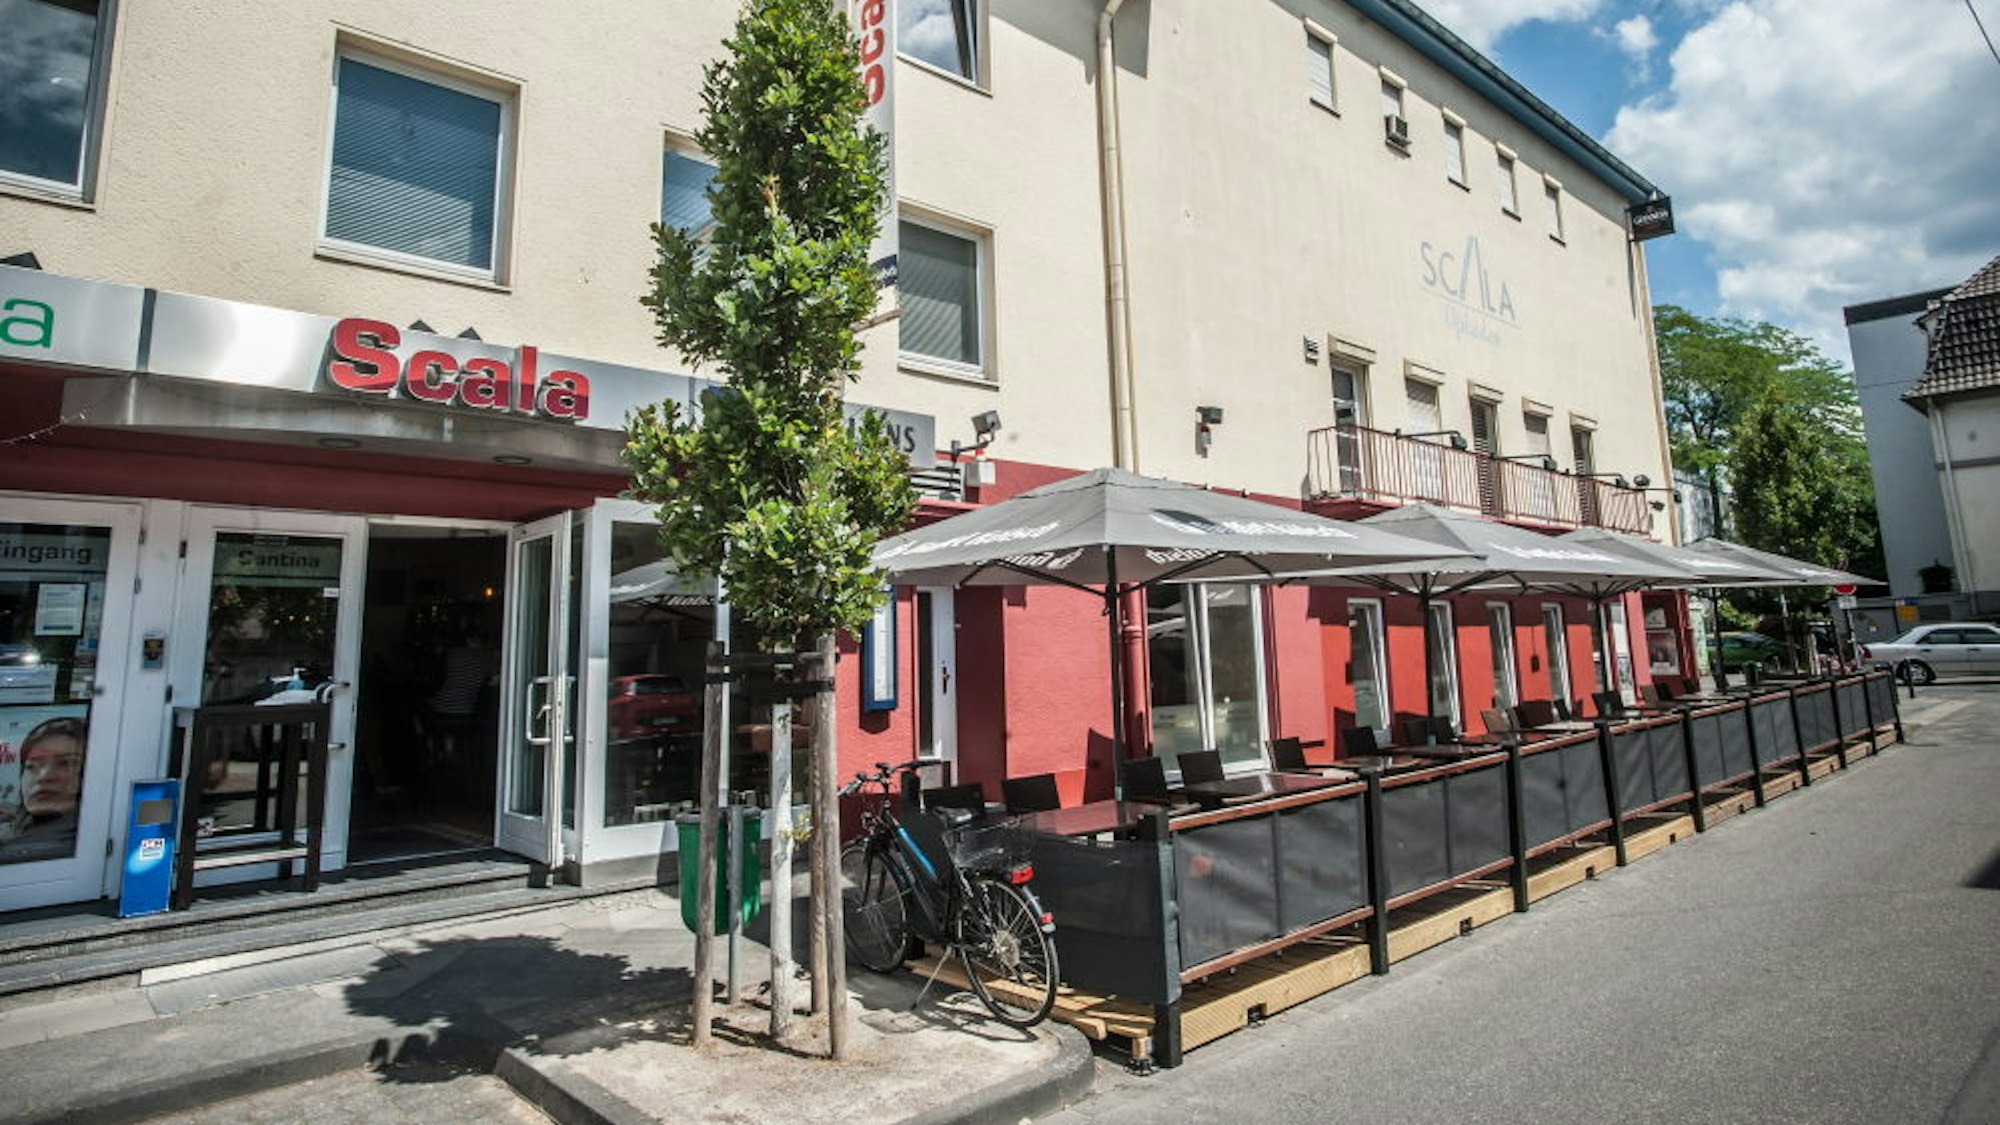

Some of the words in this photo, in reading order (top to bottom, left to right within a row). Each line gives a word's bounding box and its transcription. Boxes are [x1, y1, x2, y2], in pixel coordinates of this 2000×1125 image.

[1420, 235, 1516, 322] SCALA
[327, 317, 592, 420] Scala
[0, 540, 91, 565] ingang
